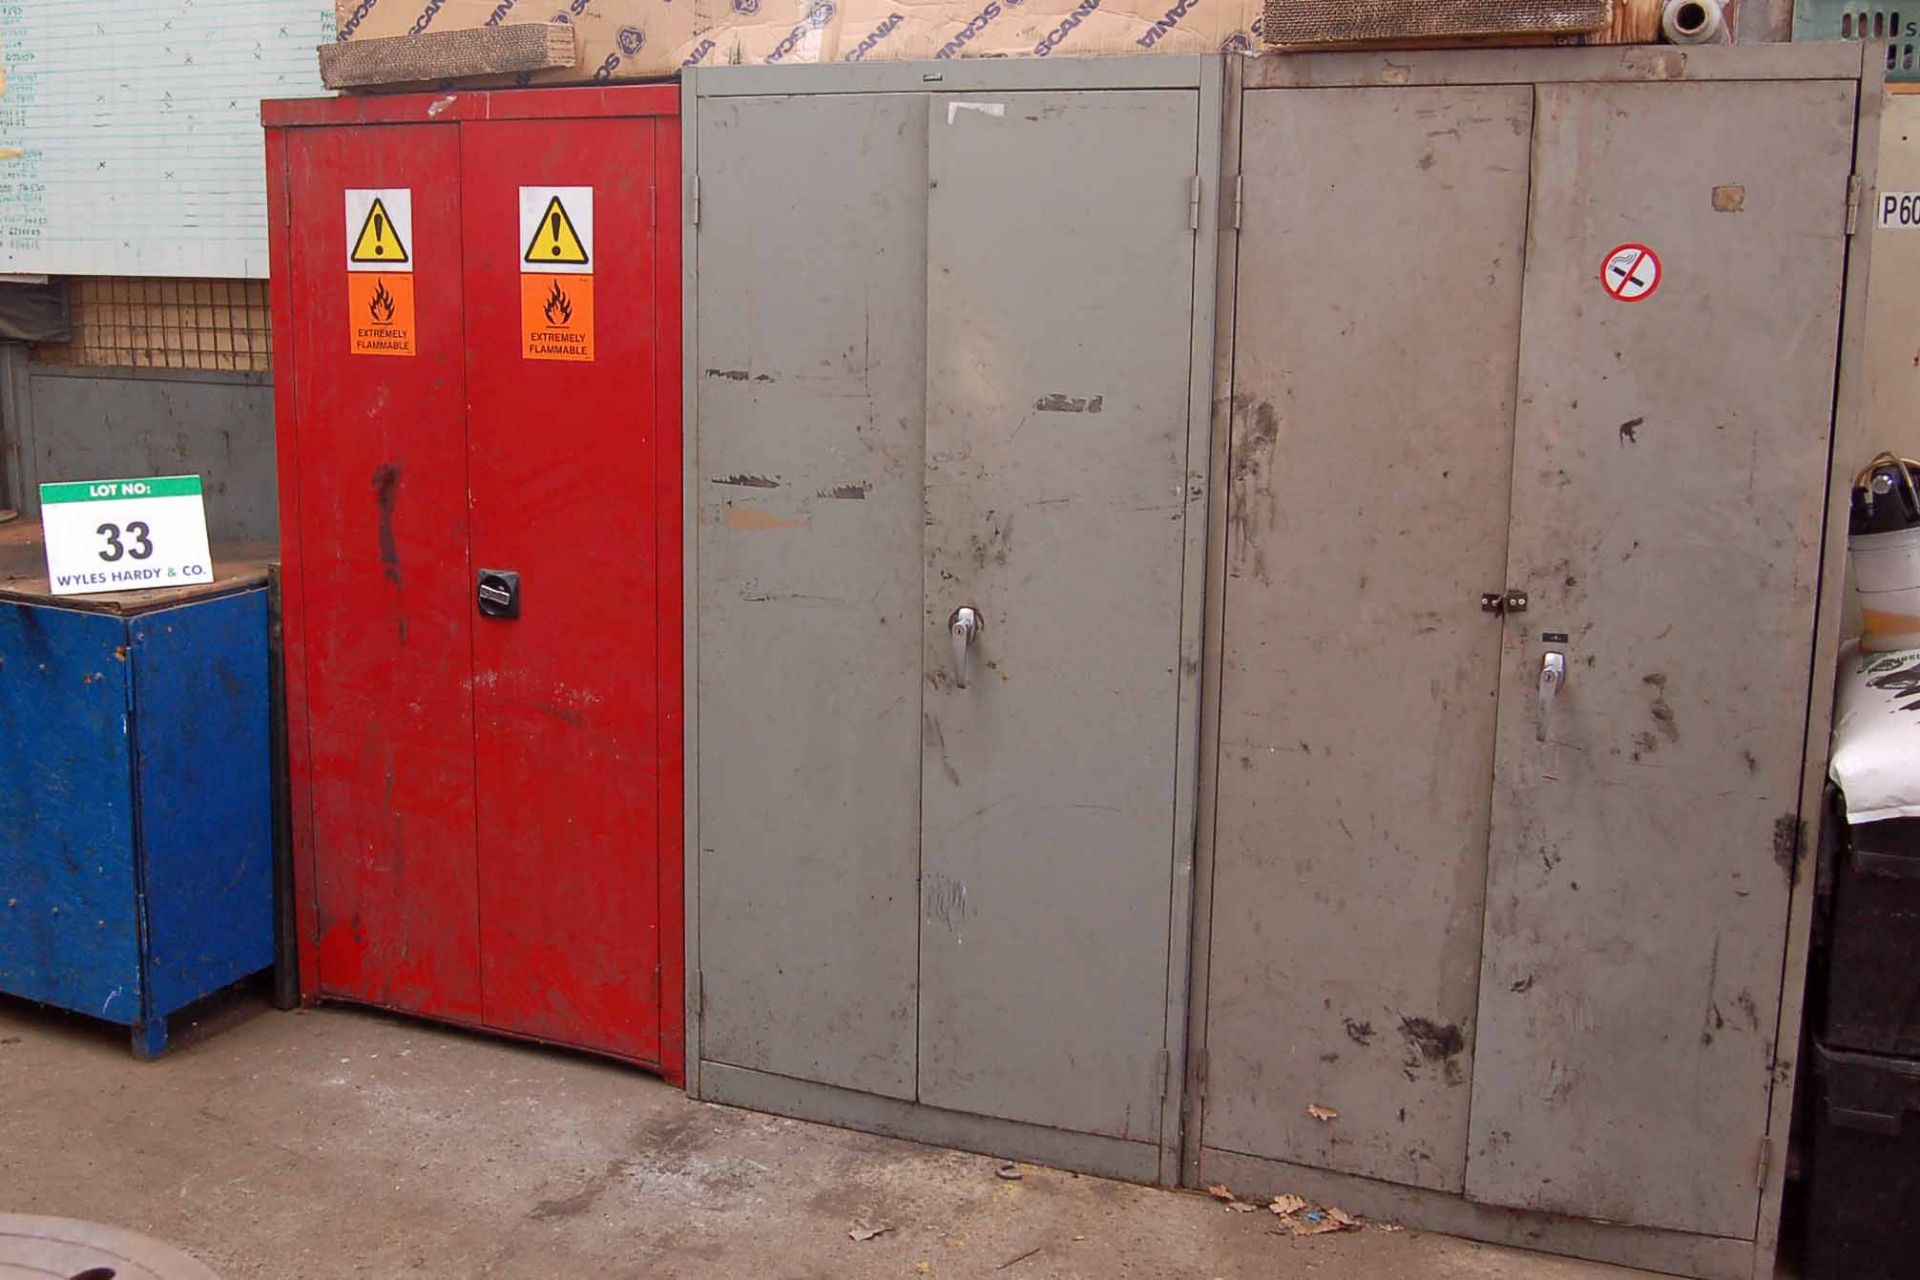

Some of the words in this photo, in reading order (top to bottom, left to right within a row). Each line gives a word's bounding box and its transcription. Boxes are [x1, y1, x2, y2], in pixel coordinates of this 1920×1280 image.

[358, 328, 408, 339] EXTREMELY
[530, 332, 586, 343] EXTREMELY
[356, 340, 410, 351] FLAMMABLE
[529, 344, 588, 356] FLAMMABLE
[89, 484, 117, 497] LOT
[122, 482, 151, 496] NO:
[96, 521, 154, 562] 33
[57, 572, 106, 587] WYLES
[112, 568, 161, 582] HARDY
[167, 566, 177, 578] &
[182, 564, 207, 577] CO.
